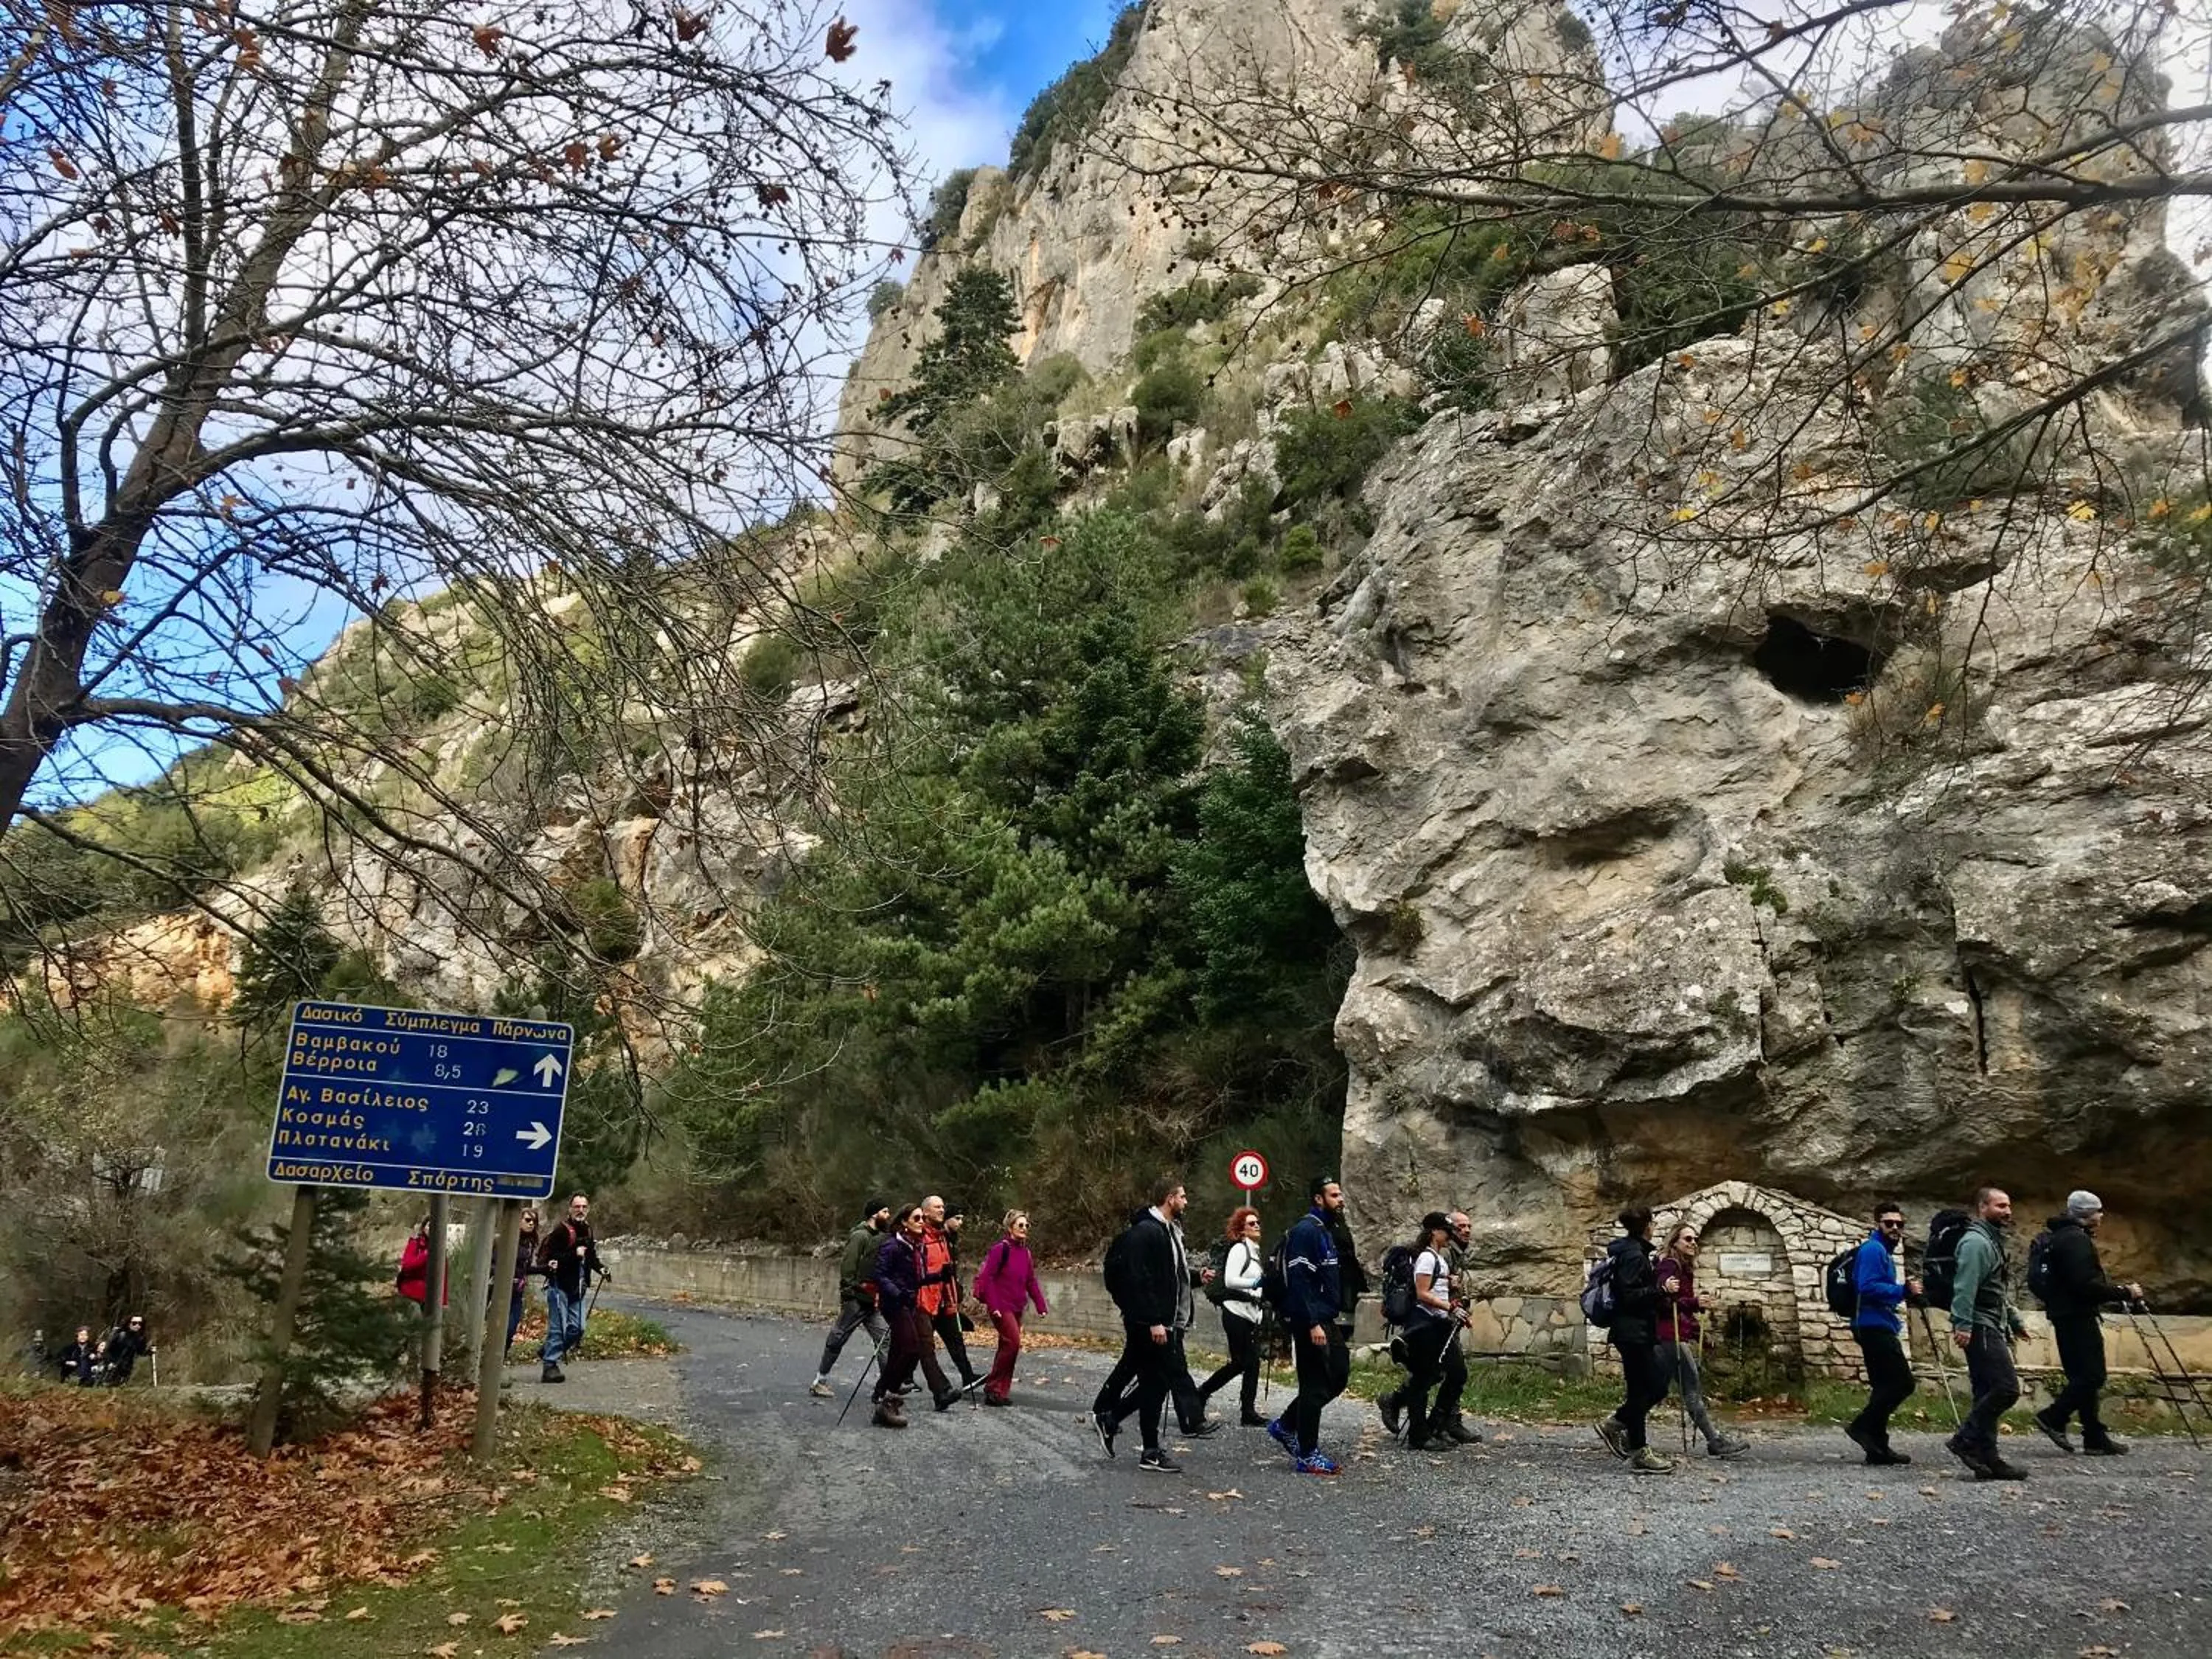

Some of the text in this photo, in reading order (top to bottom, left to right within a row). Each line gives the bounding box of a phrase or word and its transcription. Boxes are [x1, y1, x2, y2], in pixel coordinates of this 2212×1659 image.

[301, 1005, 567, 1040] Δασικό Σύμπλεγμα Πάρνωνα
[296, 1032, 448, 1058] Βαμβακού 18
[293, 1050, 462, 1080] Βέρροια 8,5
[287, 1085, 490, 1115] Αγ. Βασίλειος 23
[282, 1107, 364, 1130] Κοσμάς
[462, 1144, 483, 1158] 19
[274, 1162, 494, 1192] Δασαρχείο Σπάρτης
[1239, 1164, 1259, 1178] 40
